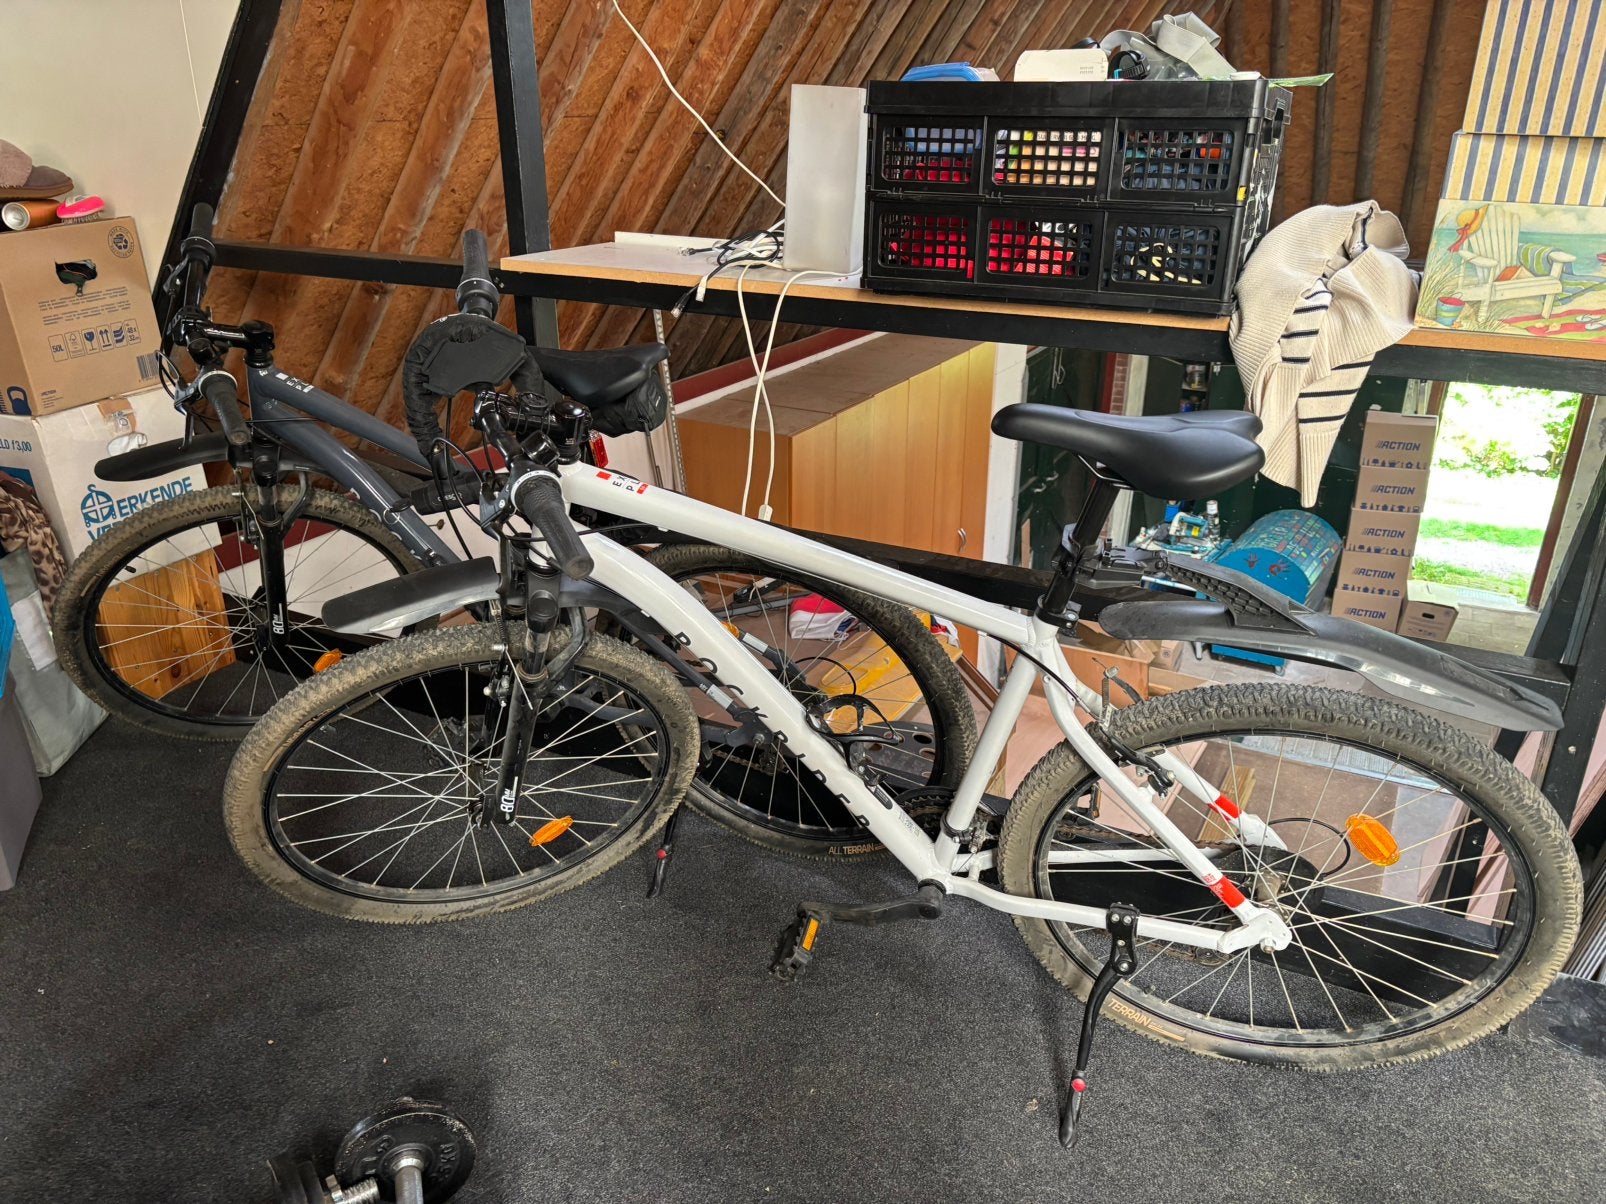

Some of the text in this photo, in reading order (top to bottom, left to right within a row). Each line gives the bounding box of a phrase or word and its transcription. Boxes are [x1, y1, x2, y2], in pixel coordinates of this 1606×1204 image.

[0, 438, 10, 450] LD
[1382, 439, 1421, 452] ACTION
[1376, 484, 1416, 496] ACTION
[116, 476, 193, 518] ERKENDE
[1366, 527, 1405, 539] ACTION
[1357, 567, 1396, 580] ACTION
[1349, 607, 1387, 620] ACTION
[500, 795, 516, 813] 80
[828, 845, 843, 855] ALL
[842, 842, 876, 855] TERRAIN
[1107, 997, 1152, 1028] TERRAIN
